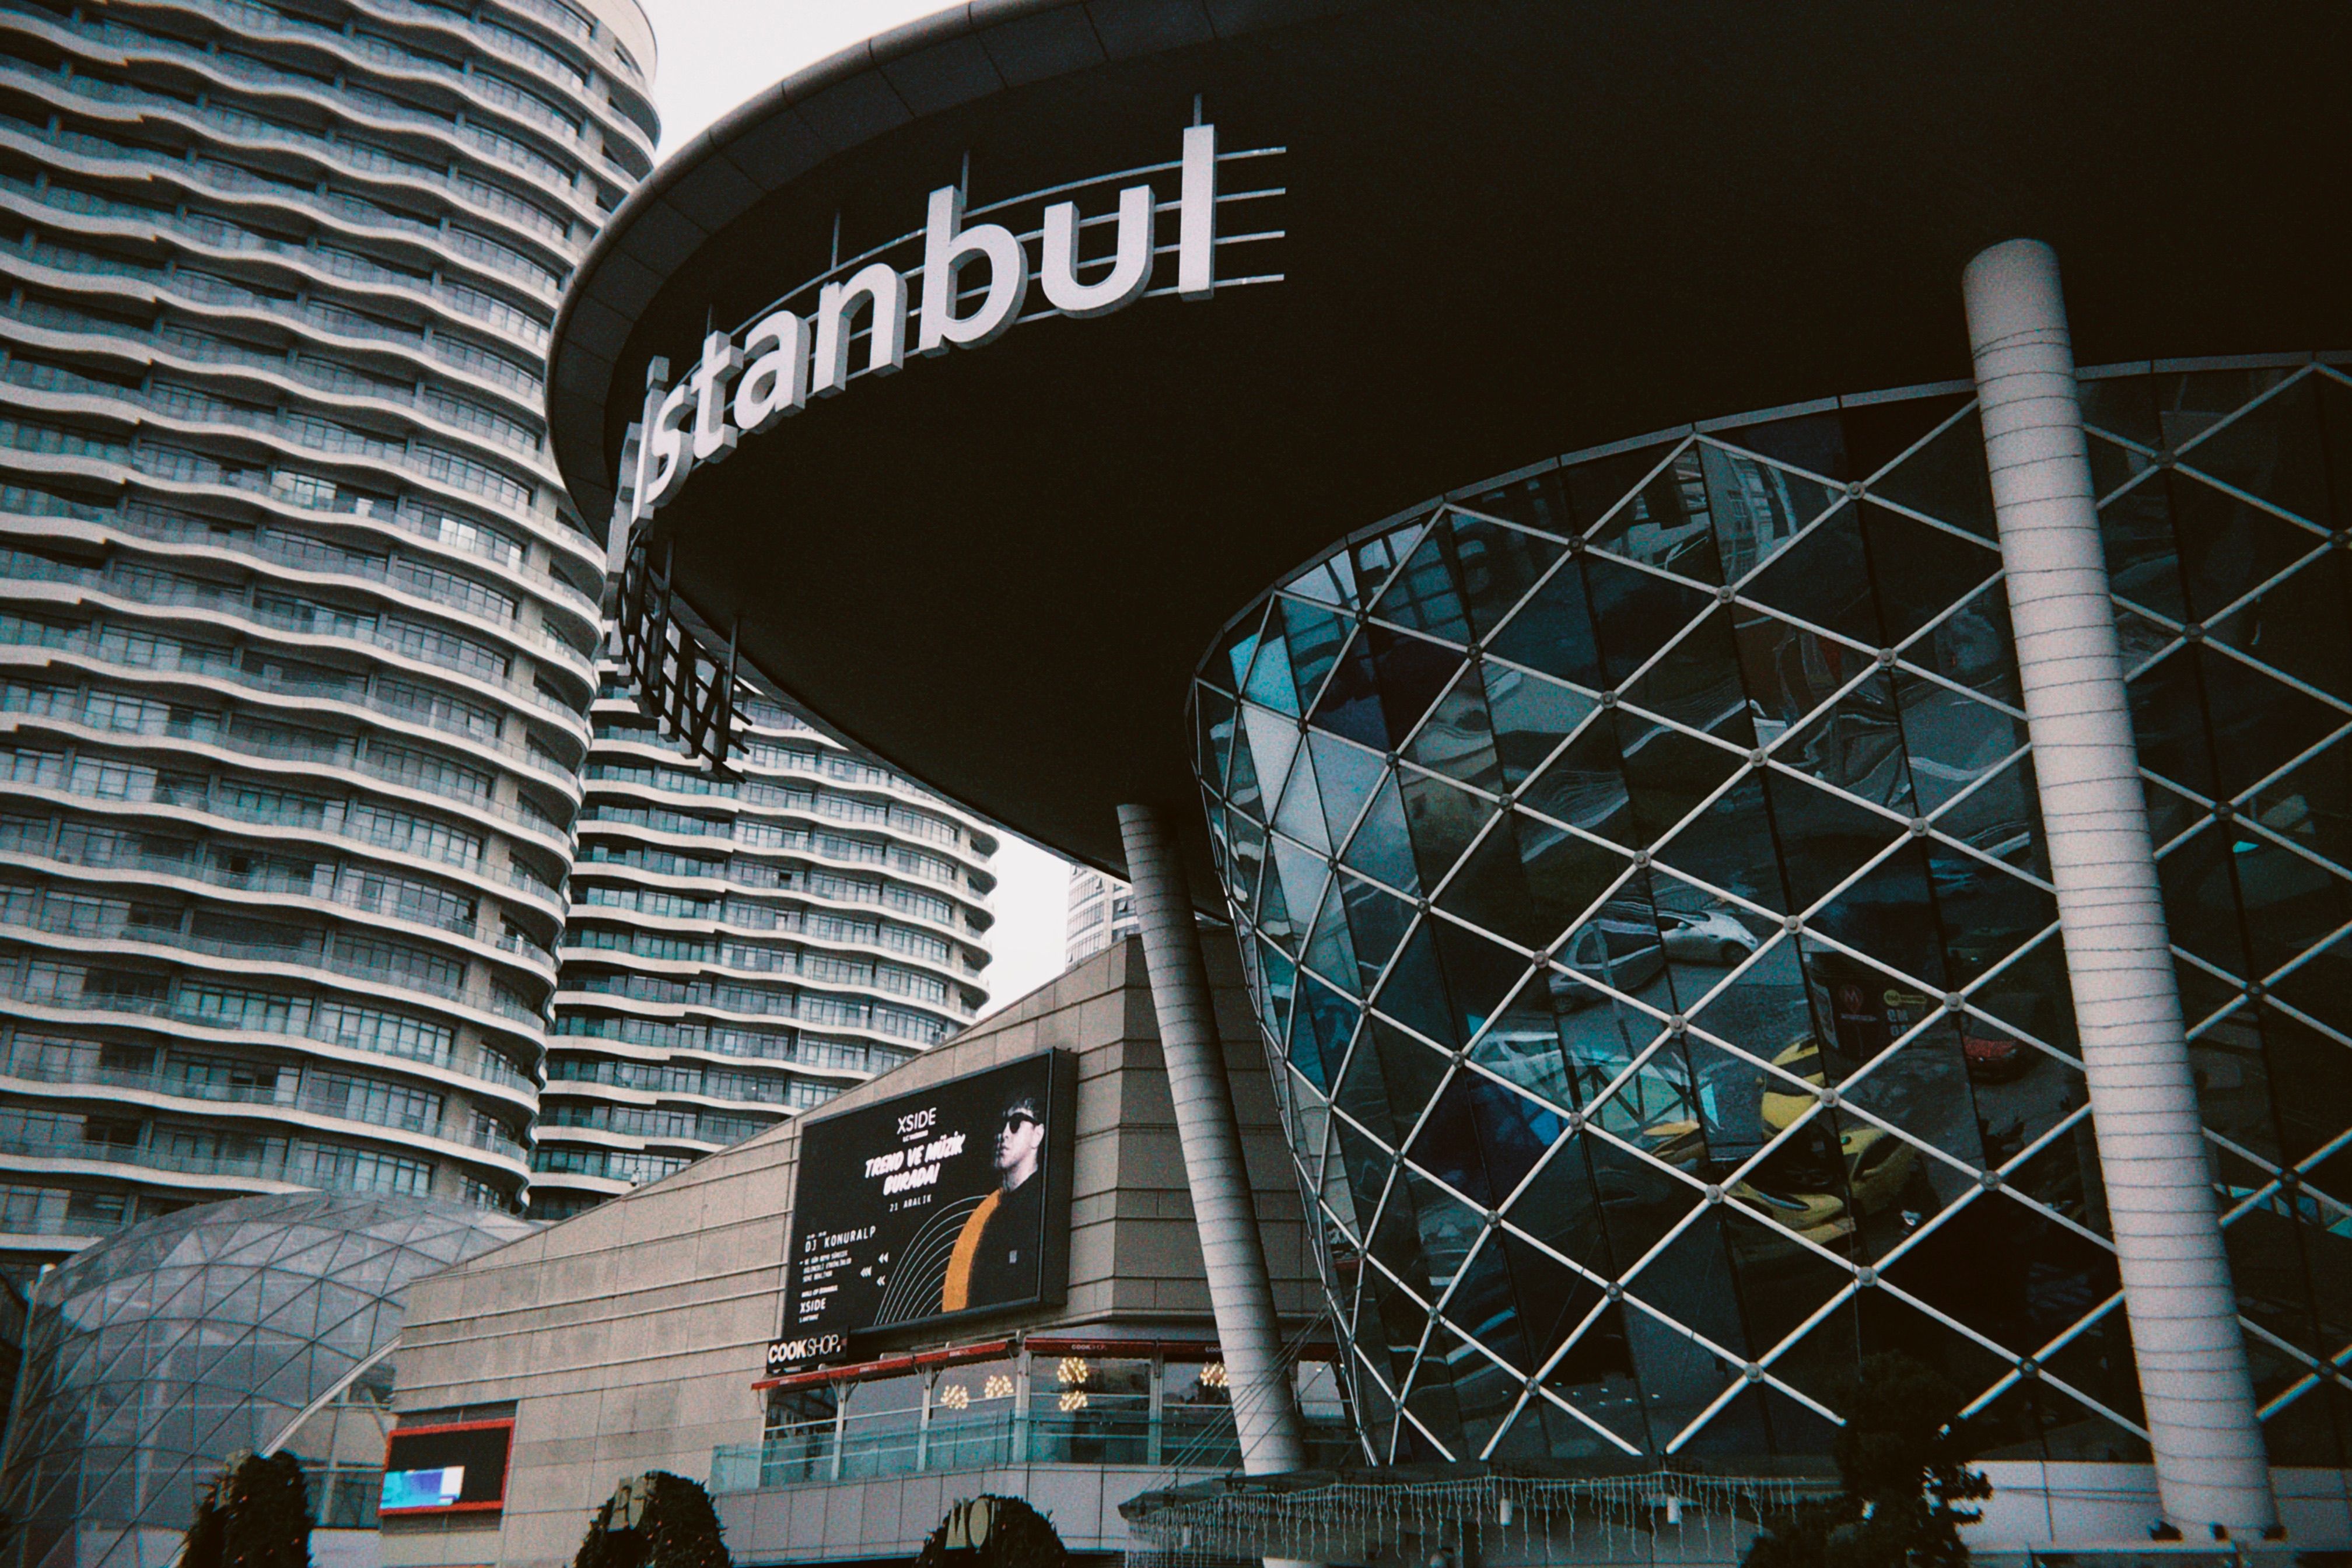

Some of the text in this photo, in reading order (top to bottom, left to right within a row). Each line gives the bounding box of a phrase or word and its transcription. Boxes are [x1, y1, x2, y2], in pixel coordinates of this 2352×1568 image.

[897, 1107, 937, 1135] XSIDE
[864, 1150, 904, 1179] TREND
[907, 1144, 925, 1167] VE
[924, 1130, 966, 1163] MÜZİK
[889, 1194, 932, 1212] 21 ARALIK
[804, 1240, 817, 1253] DJ
[824, 1225, 876, 1248] KONURALP
[799, 1297, 827, 1314] XSIDE
